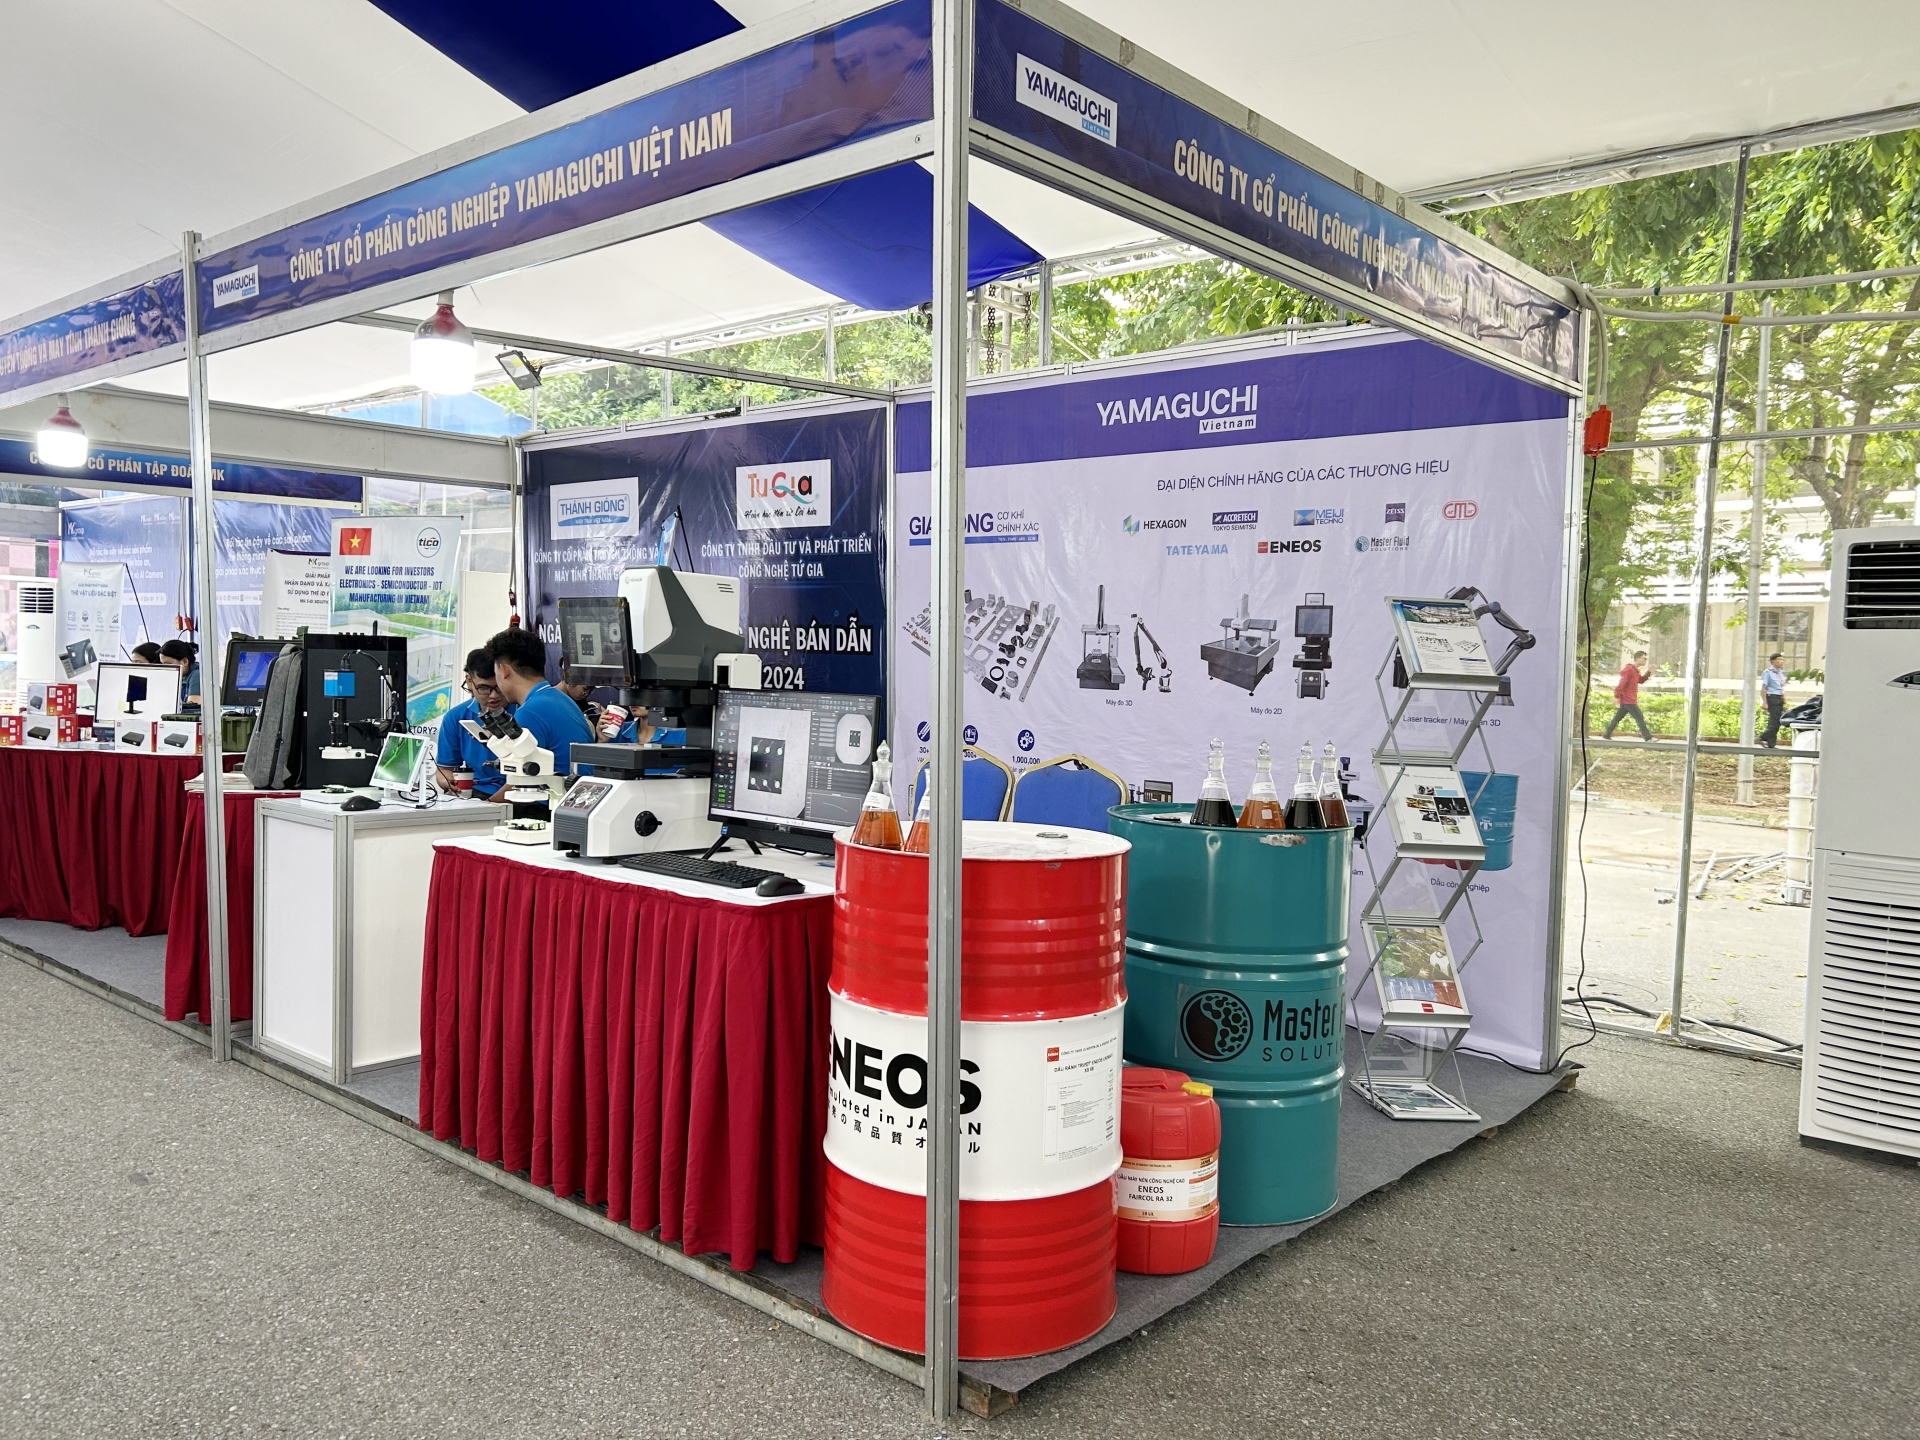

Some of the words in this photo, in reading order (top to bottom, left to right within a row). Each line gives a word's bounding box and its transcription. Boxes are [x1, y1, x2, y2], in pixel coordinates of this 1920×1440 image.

[1024, 67, 1111, 128] YAMAGUCHI
[1082, 119, 1110, 140] Vietnam
[290, 248, 323, 283] CÔNG
[326, 241, 340, 272] TY
[344, 222, 363, 266] CỔ
[366, 213, 403, 260] PHẦN
[406, 207, 447, 247] CÔNG
[451, 182, 510, 233] NGHIỆP
[515, 146, 623, 212] YAMAGUCHI
[629, 126, 674, 177] VIỆT
[679, 107, 732, 160] NAM
[1174, 138, 1223, 195] CÔNG
[1230, 164, 1249, 205] TY
[1252, 172, 1276, 218] CỔ
[1278, 191, 1319, 240] PHẦN
[1321, 212, 1358, 260] CÔNG
[215, 272, 256, 296] YAMAGUCHI
[49, 334, 64, 360] MÁY
[1096, 384, 1259, 427] YAMAGUCHI
[1202, 416, 1255, 432] Vietnam
[87, 453, 105, 470] CỔ
[108, 457, 142, 474] PHẦN
[145, 460, 167, 478] TẬP
[171, 463, 193, 478] ĐOÀ
[1157, 479, 1176, 493] ĐẠI
[1178, 475, 1205, 491] DIỆN
[1207, 473, 1244, 488] CHÍNH
[1247, 470, 1283, 485] HÃNG
[1286, 467, 1315, 483] CỦA
[1317, 465, 1345, 481] CÁC
[1348, 462, 1412, 478] THƯƠNG
[1415, 459, 1450, 476] HIỆU
[560, 500, 591, 515] THÁNH
[594, 497, 625, 513] GIÓNG
[997, 511, 1010, 520] CƠ
[1011, 508, 1025, 520] KHÍ
[1315, 508, 1344, 519] MEIJI
[964, 512, 994, 533] NG
[1143, 518, 1187, 531] HEXAGON
[1222, 512, 1256, 523] ACCRETECH
[997, 522, 1021, 533] CHÍNH
[1022, 521, 1039, 532] XÁC
[701, 538, 723, 557] CÔNG
[725, 543, 735, 556] TY
[762, 538, 782, 556] ĐẦU
[783, 540, 798, 554] TƯ
[799, 537, 812, 554] VÀ
[814, 535, 840, 554] PHÁT
[842, 532, 872, 553] TRIỂN
[1270, 539, 1322, 553] ENEOS
[1370, 537, 1393, 546] Master
[1393, 536, 1410, 546] Fluid
[534, 549, 552, 563] CÔNG
[562, 546, 573, 562] CỔ
[1166, 544, 1228, 555] TATEYAMA
[145, 571, 164, 579] Camera
[344, 565, 353, 575] WE
[355, 565, 366, 575] ARE
[367, 566, 390, 575] LOOKING
[392, 566, 403, 576] FOR
[404, 566, 435, 576] INVESTORS
[554, 566, 571, 581] MÁY
[738, 560, 762, 578] CÔNG
[764, 560, 789, 580] NGHỆ
[791, 560, 804, 577] TỨ
[806, 563, 824, 577] GIA
[339, 579, 376, 589] ELECTRONICS
[380, 580, 427, 590] SEMICONDUCTOR
[432, 581, 443, 590] IOT
[349, 593, 396, 603] MANUFACTURING
[397, 594, 404, 603] IN
[405, 594, 430, 604] VIETNAM
[539, 618, 562, 643] NGÀ
[748, 619, 791, 656] NGHỆ
[796, 620, 830, 651] BÁN
[836, 617, 872, 652] DẪN
[763, 666, 804, 690] 2024
[1105, 698, 1116, 707] Máy
[1250, 706, 1263, 715] Máy
[1264, 707, 1272, 715] đo
[1402, 715, 1422, 724] Laser
[1423, 715, 1448, 724] tracker
[1453, 716, 1469, 727] Máy
[1489, 718, 1501, 727] 3D
[919, 746, 930, 754] 30+
[1263, 998, 1338, 1041] Master
[829, 1029, 982, 1115] NEOS
[829, 1086, 870, 1118] mulated
[879, 1108, 895, 1125] in
[1138, 1175, 1149, 1183] NÉN
[1149, 1176, 1162, 1184] CÔNG
[1129, 1193, 1154, 1202] FAIRCOL
[1138, 1185, 1164, 1194] ENEOS
